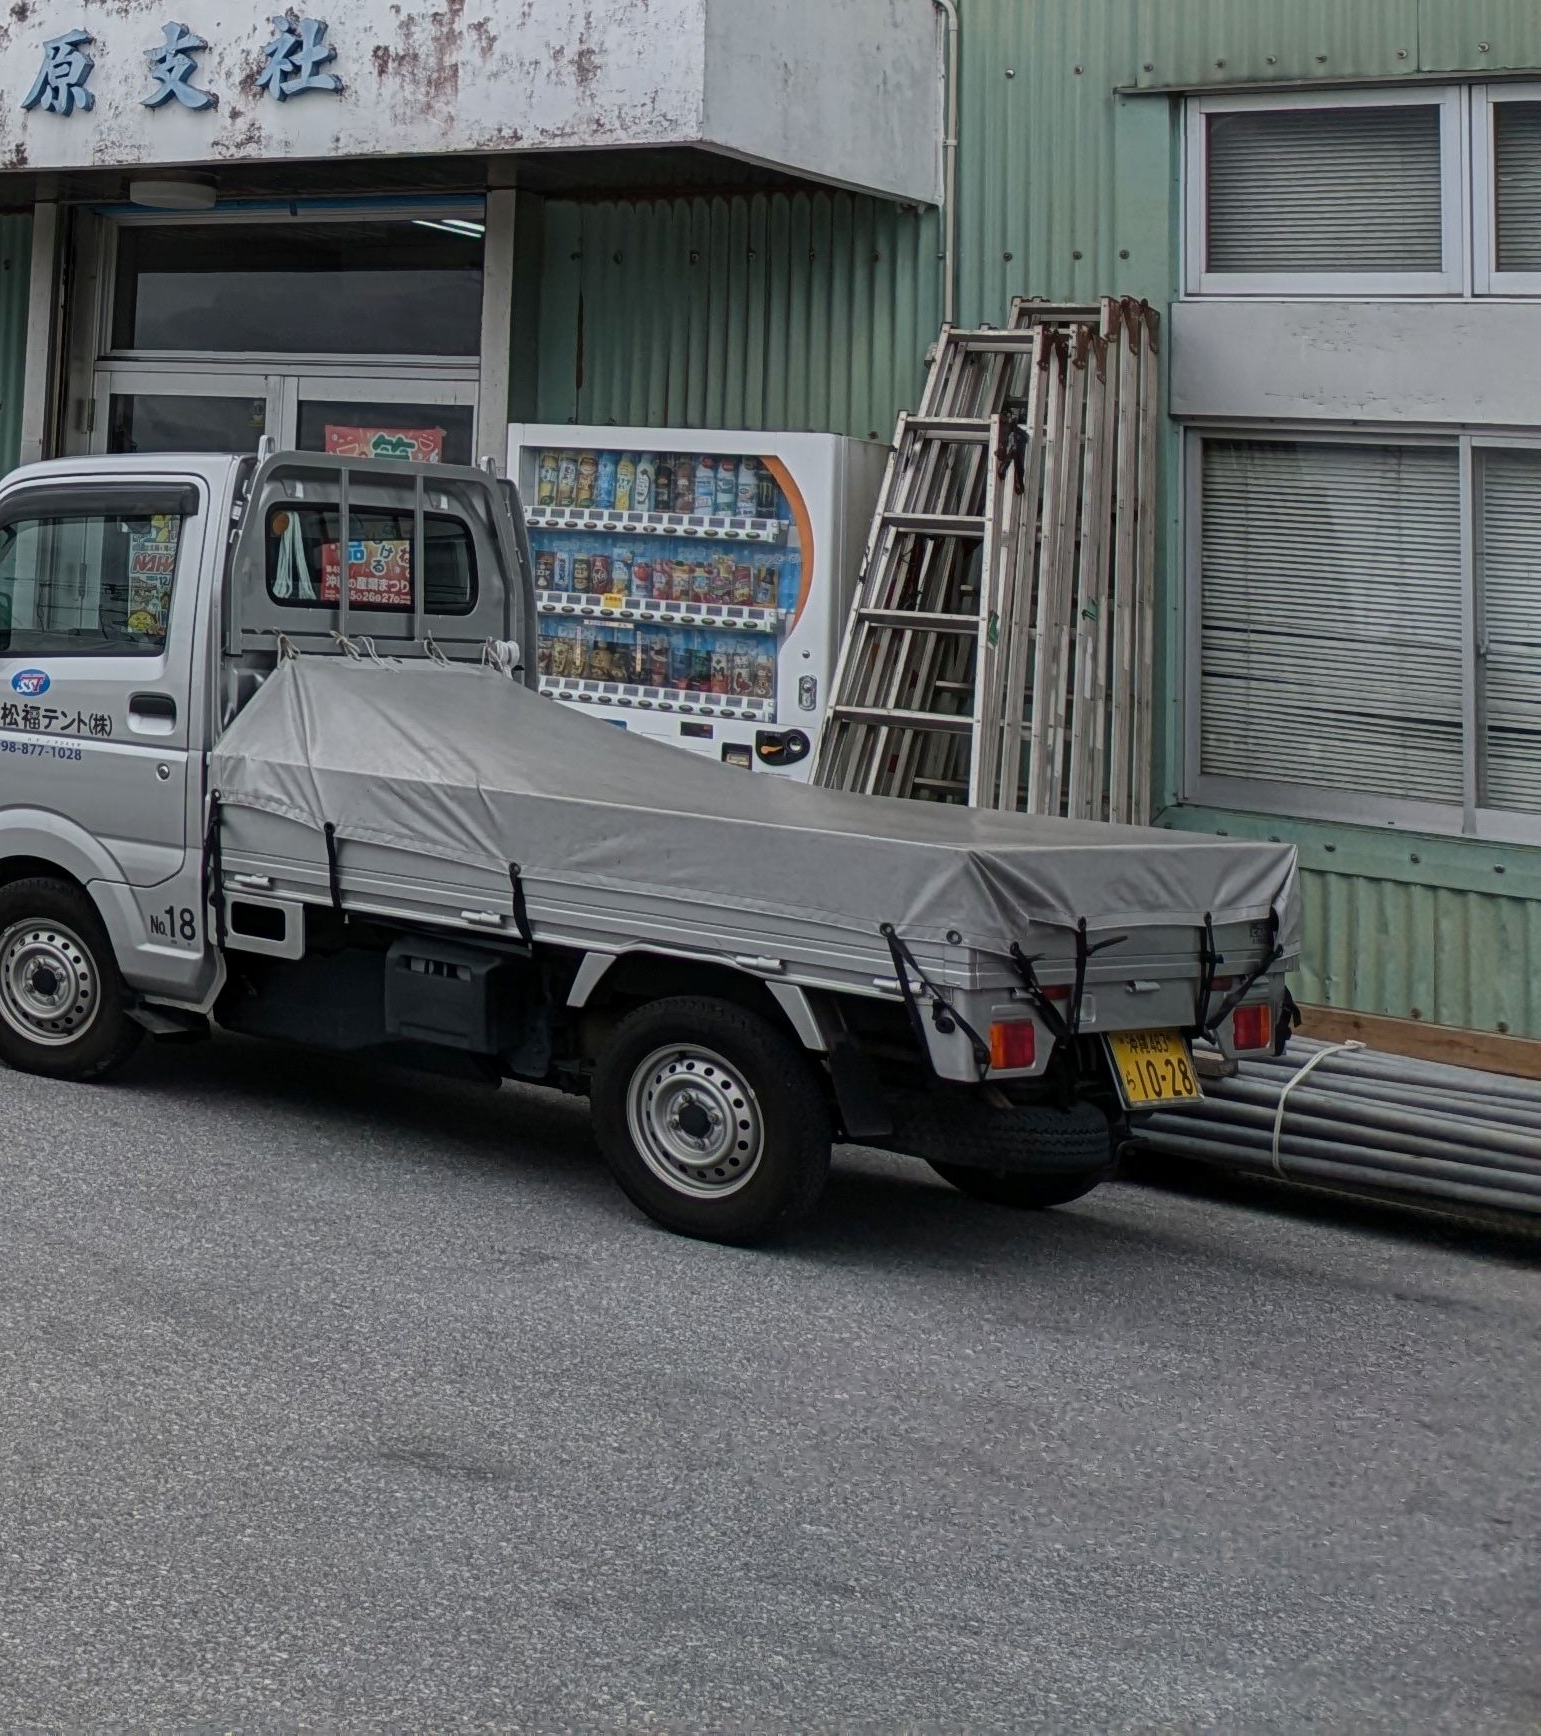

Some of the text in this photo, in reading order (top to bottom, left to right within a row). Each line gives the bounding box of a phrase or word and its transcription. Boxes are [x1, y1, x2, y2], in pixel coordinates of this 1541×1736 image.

[325, 574, 410, 593] 沖の産業まつり
[1135, 1057, 1194, 1099] 10-28
